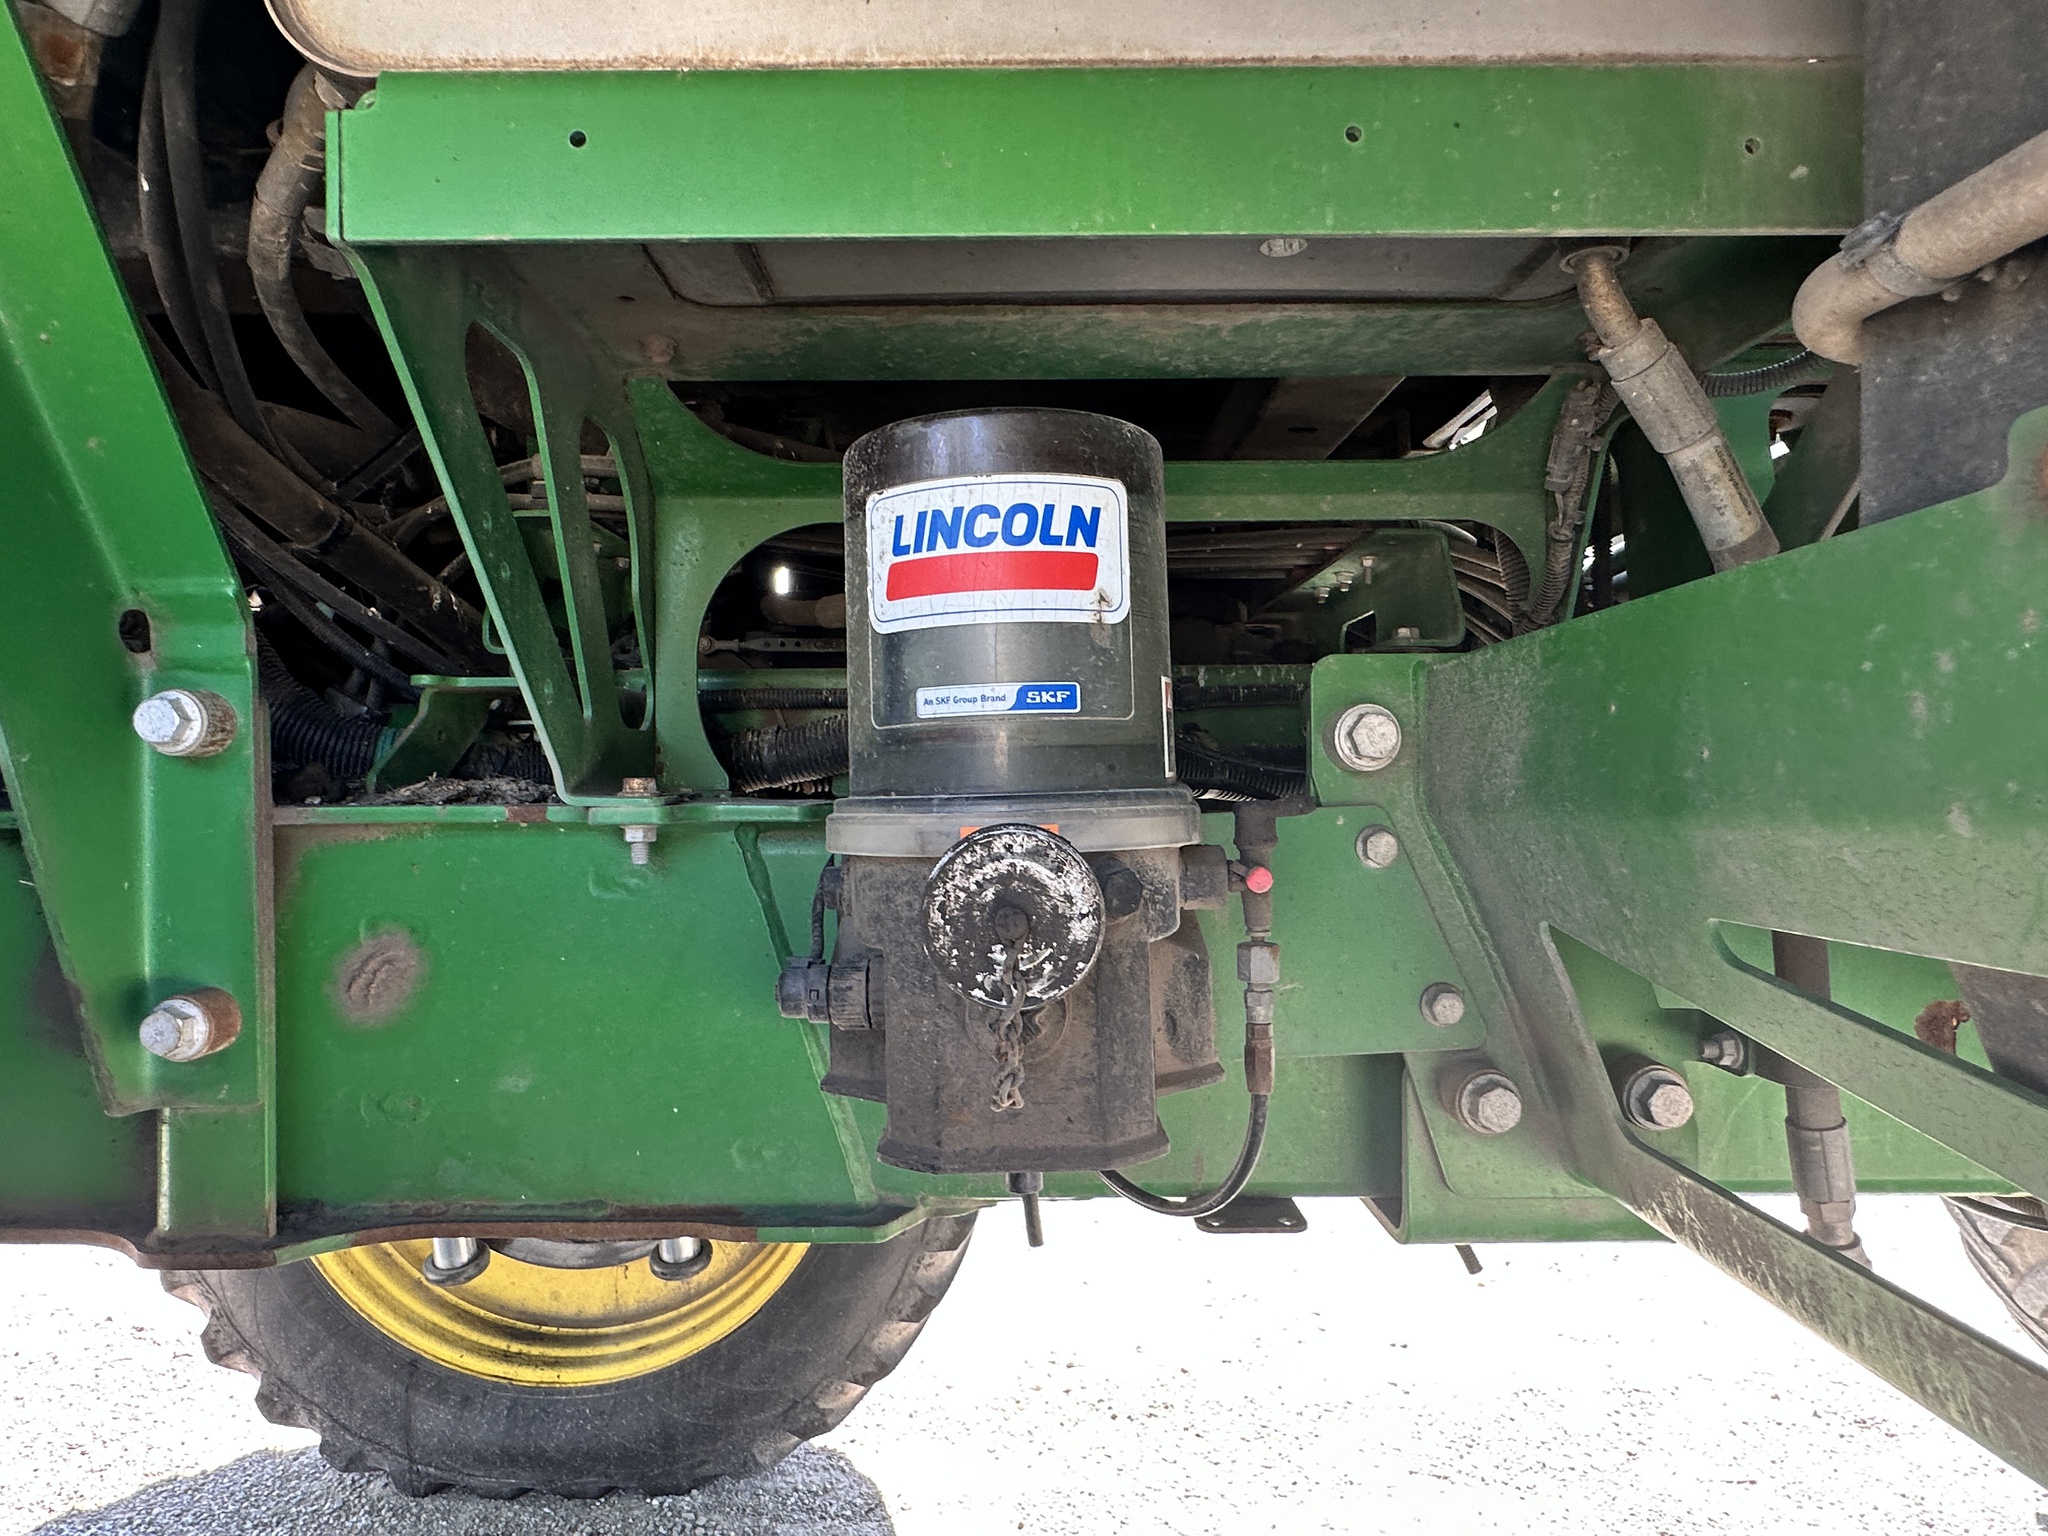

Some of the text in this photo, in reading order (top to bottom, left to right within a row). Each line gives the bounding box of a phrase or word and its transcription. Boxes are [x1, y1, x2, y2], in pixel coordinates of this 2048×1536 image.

[892, 502, 1101, 557] LINCOLN
[923, 693, 1005, 706] An SKF Group Brand
[1026, 691, 1070, 703] SKF
